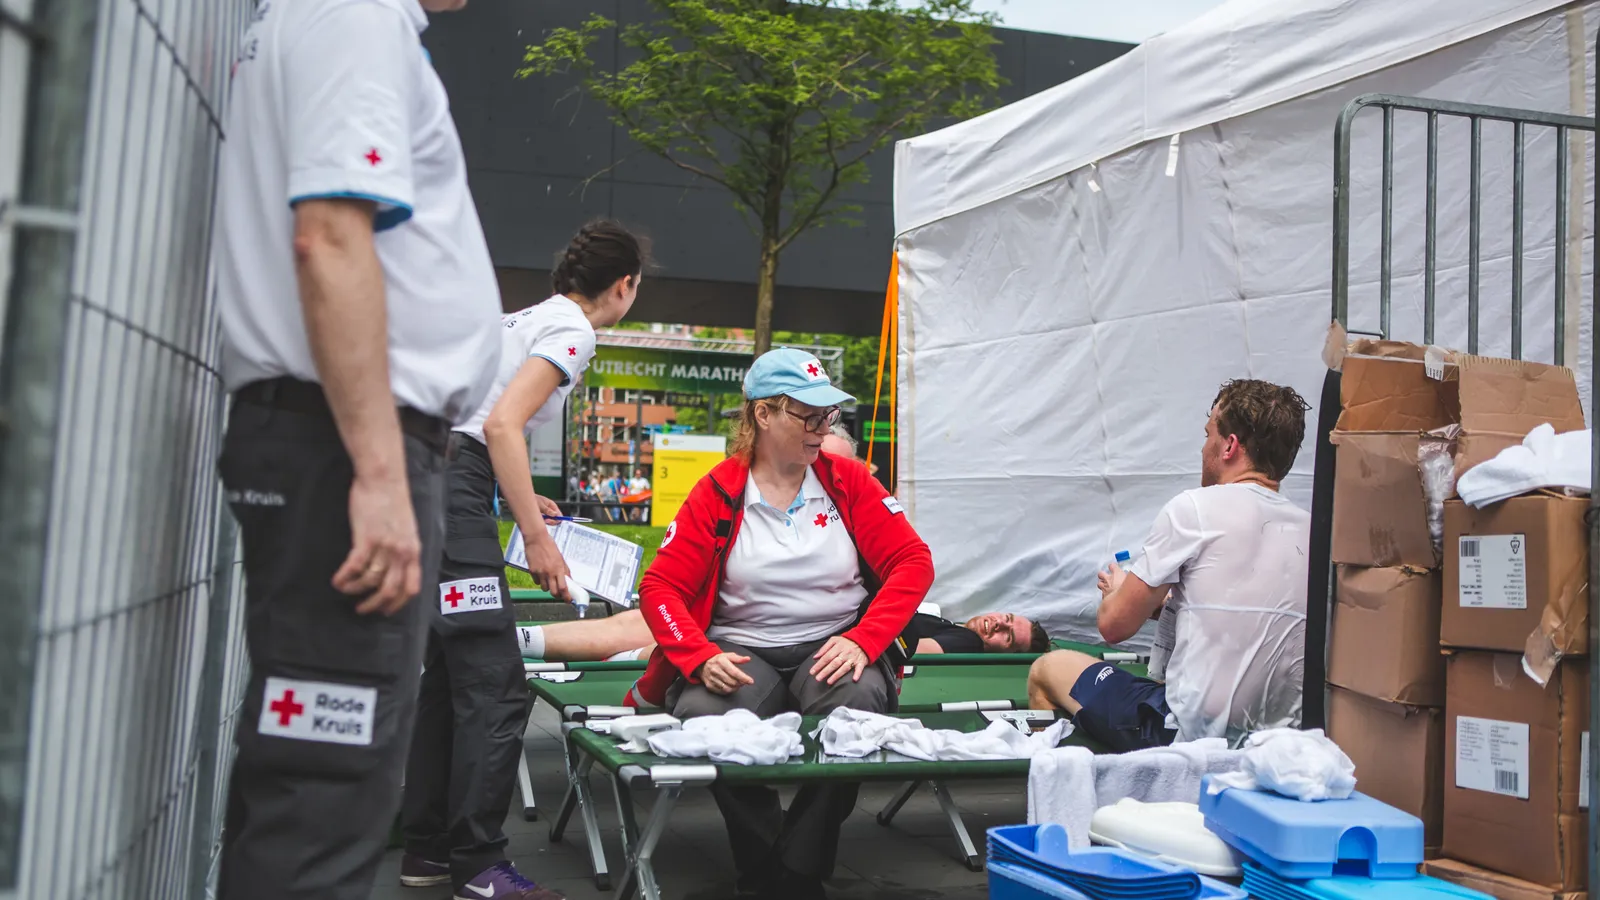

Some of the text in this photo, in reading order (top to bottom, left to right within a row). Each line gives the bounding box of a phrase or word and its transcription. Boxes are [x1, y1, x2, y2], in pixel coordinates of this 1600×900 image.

[593, 359, 749, 382] UTRECHT MARATH
[660, 466, 668, 479] 3
[468, 583, 497, 594] Rode
[470, 594, 498, 606] Kruis
[658, 604, 684, 641] Rode Kruis
[315, 692, 365, 714] Rode
[312, 714, 363, 736] Kruis
